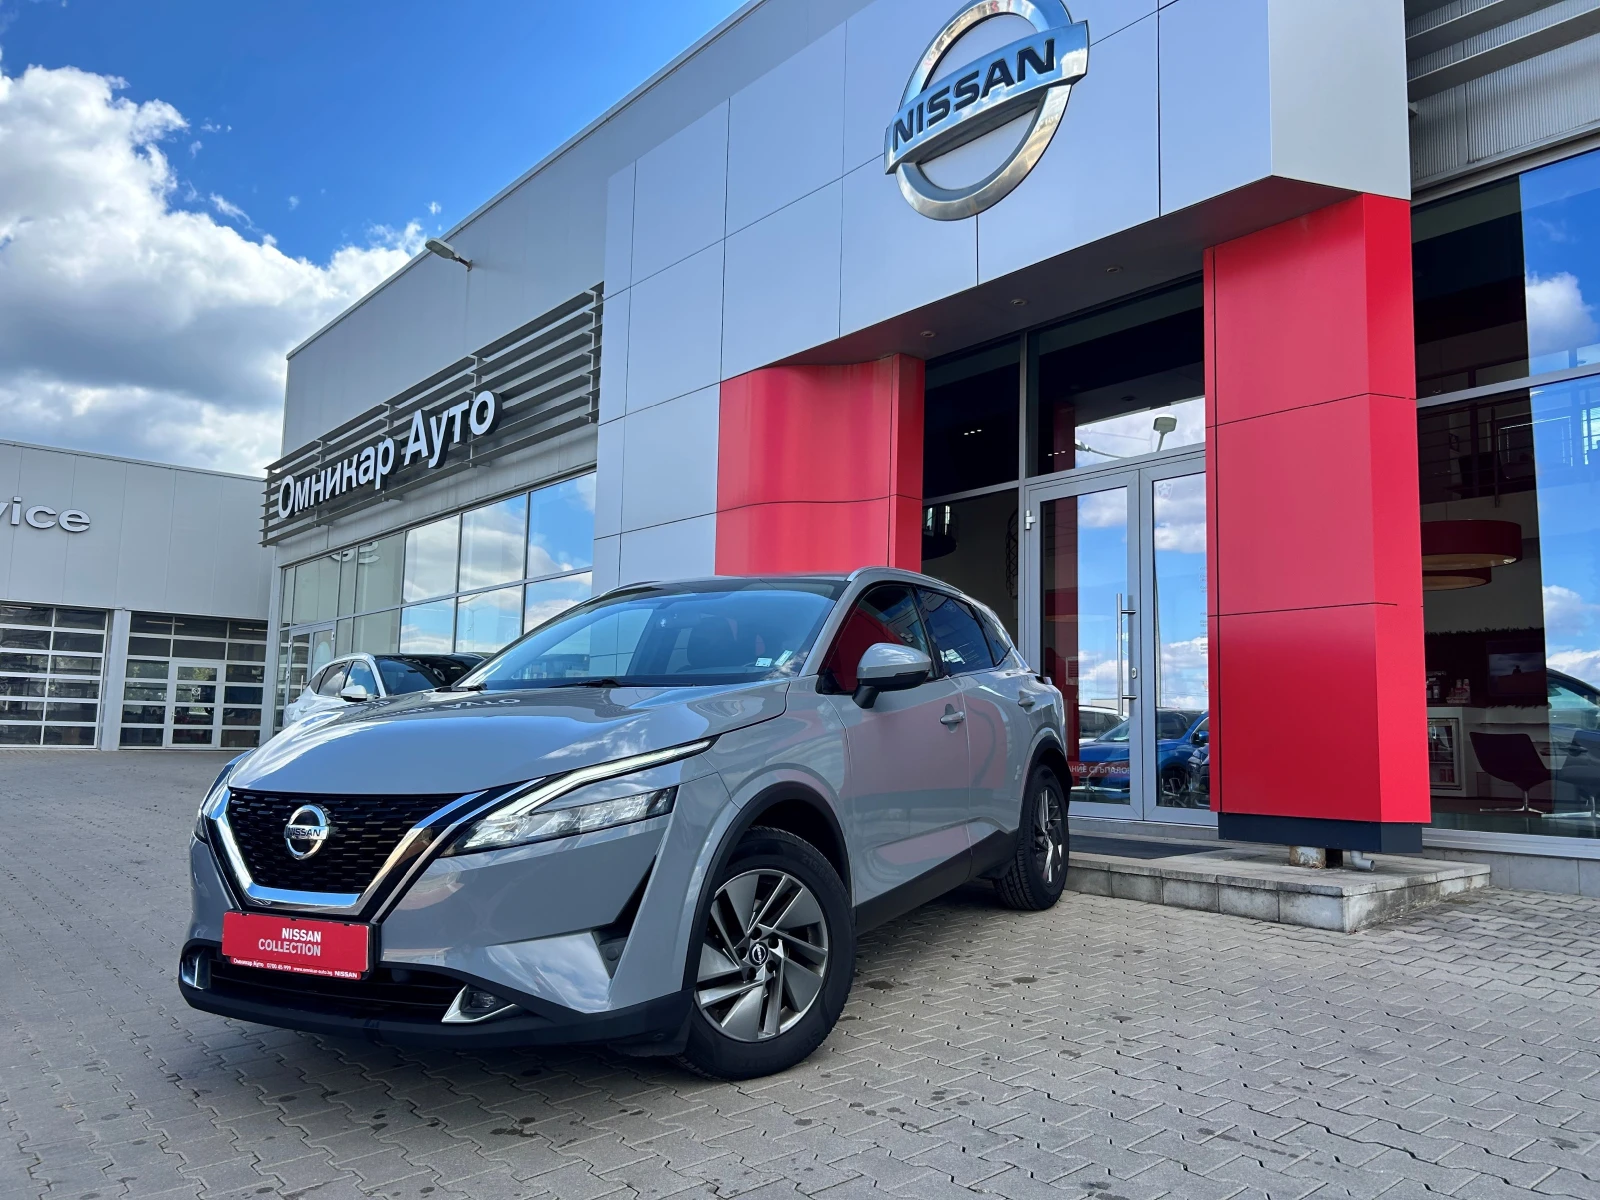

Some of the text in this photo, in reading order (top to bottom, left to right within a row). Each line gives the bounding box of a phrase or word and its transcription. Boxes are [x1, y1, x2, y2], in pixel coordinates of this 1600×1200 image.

[892, 38, 1056, 152] NISSAN
[278, 390, 497, 519] Омникар Ауто
[287, 827, 321, 837] NISSAN
[282, 927, 321, 942] NISSAN
[258, 938, 321, 956] COLLECTION
[334, 970, 358, 978] NISSAN
